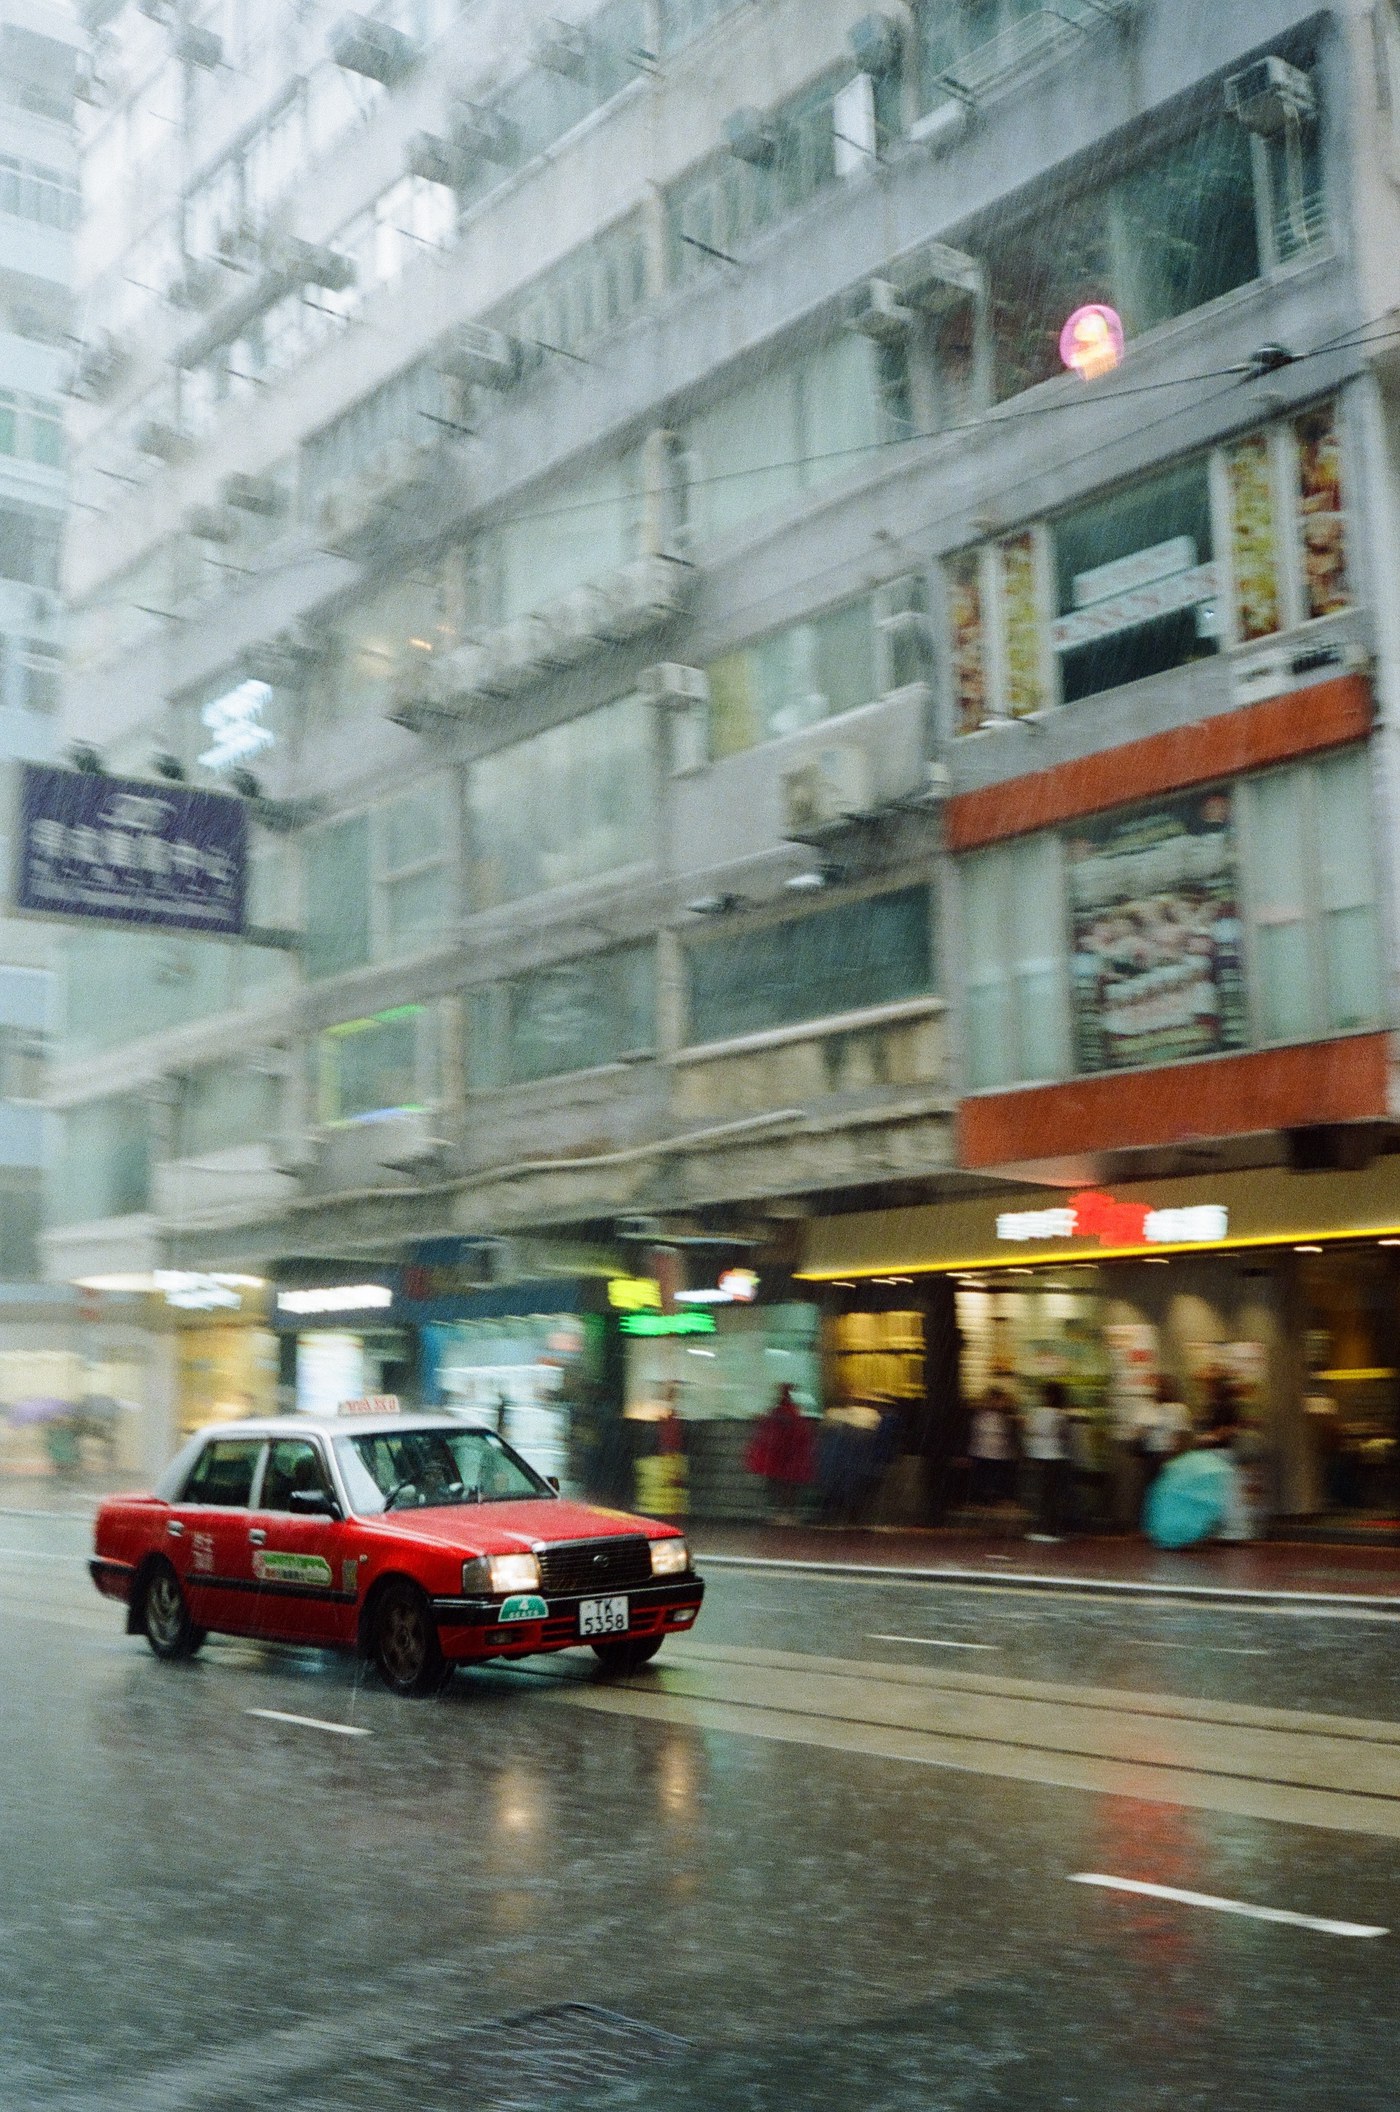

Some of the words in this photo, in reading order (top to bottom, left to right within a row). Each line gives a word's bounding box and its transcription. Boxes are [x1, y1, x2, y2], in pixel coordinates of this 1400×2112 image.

[519, 1600, 529, 1610] 4
[595, 1600, 613, 1615] TK
[585, 1614, 624, 1633] 5358
